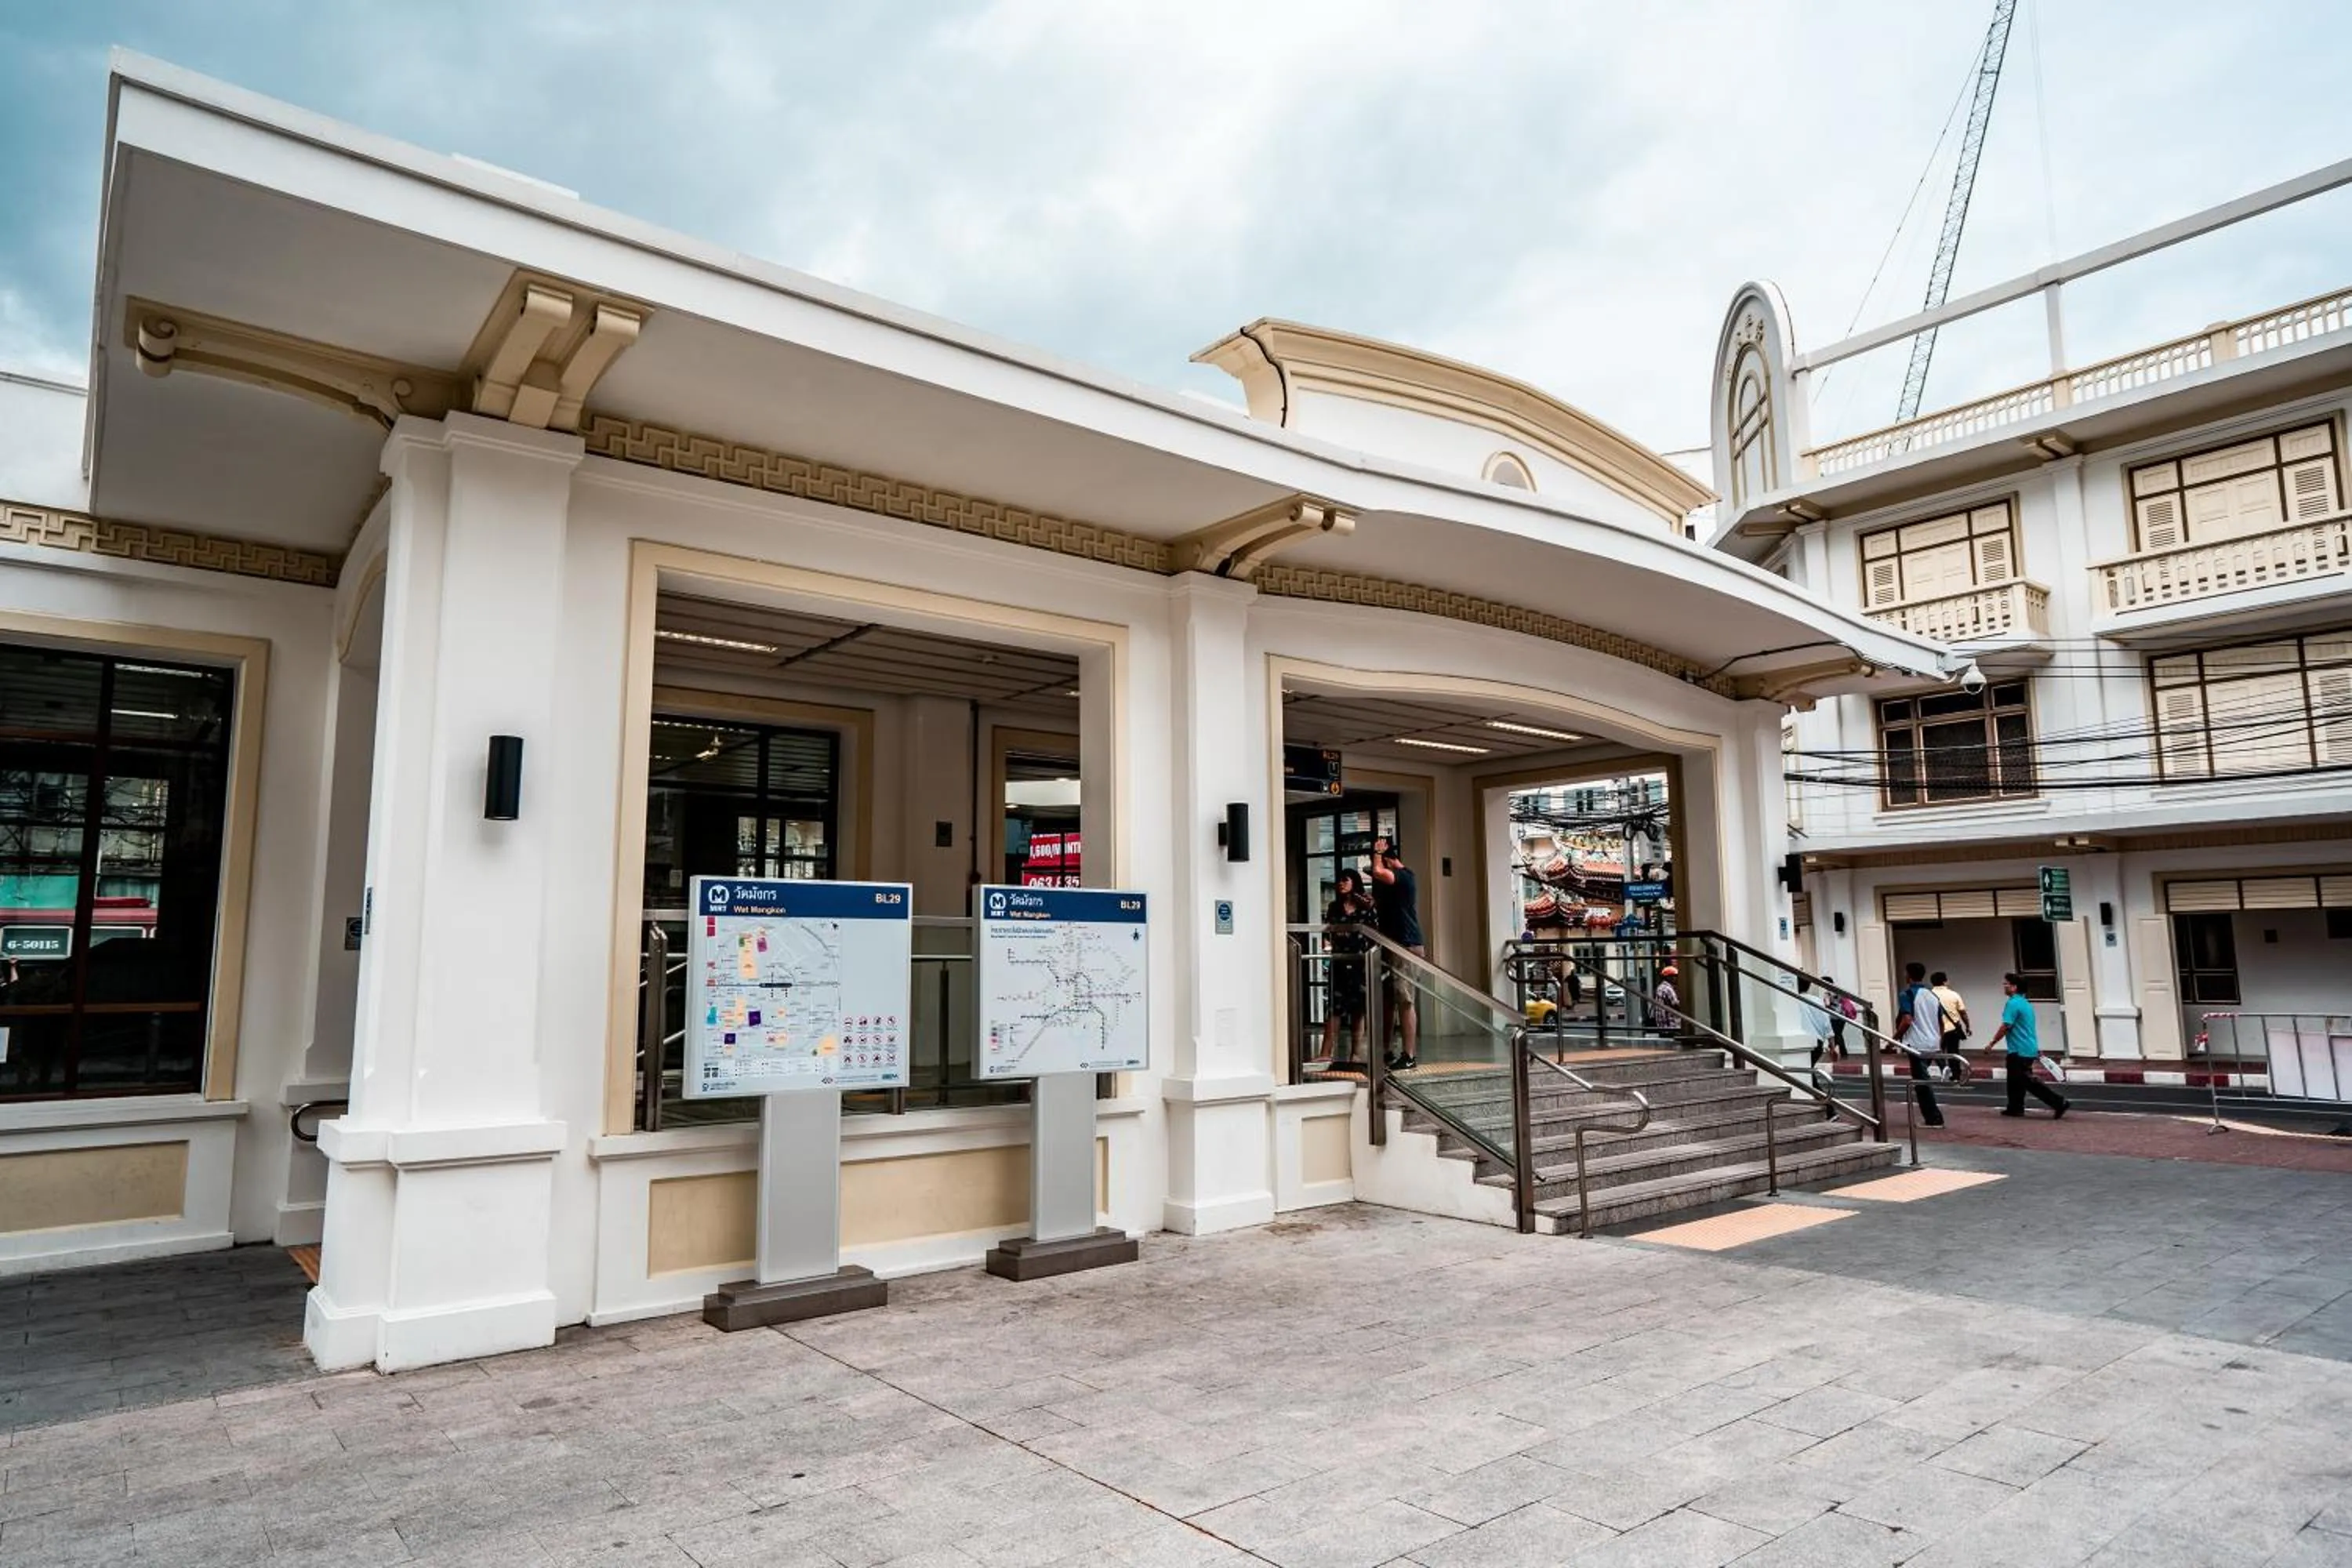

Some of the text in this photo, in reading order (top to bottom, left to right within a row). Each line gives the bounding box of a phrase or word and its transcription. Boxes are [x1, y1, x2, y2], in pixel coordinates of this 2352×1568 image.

[734, 885, 777, 901] วัดมังกร
[876, 893, 901, 904] BL29
[1120, 900, 1141, 910] BL29
[750, 906, 786, 915] Mangkon
